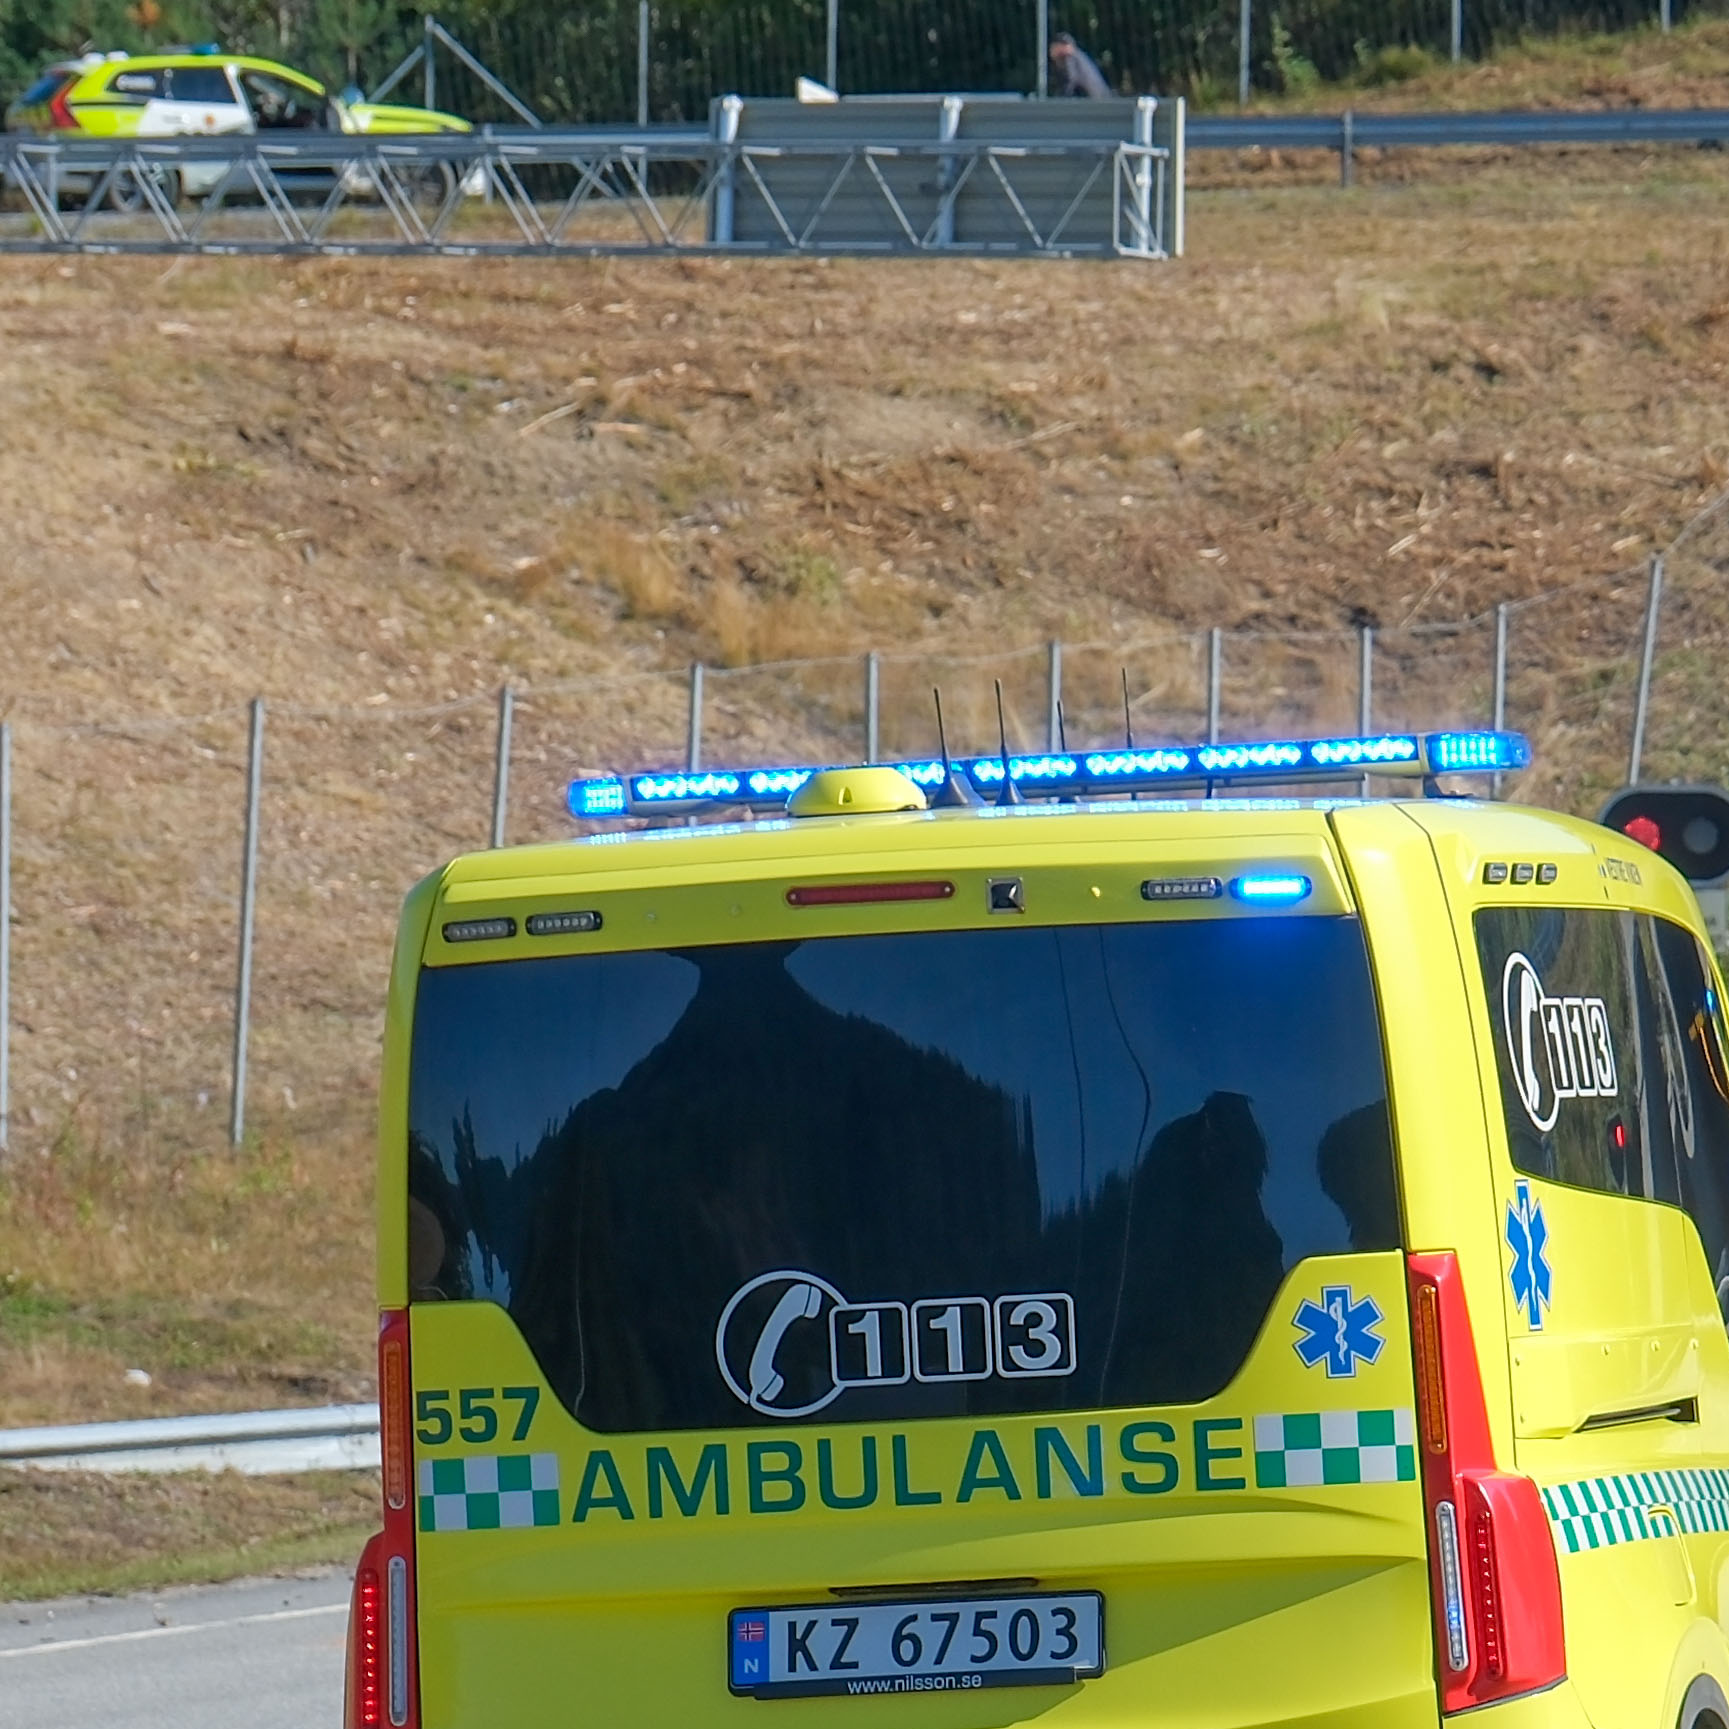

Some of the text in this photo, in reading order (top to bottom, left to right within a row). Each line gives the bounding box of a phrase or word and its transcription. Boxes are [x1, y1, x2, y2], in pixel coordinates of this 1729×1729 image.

[1546, 1005, 1614, 1089] 113
[846, 1299, 1062, 1380] 113
[416, 1386, 540, 1445] 557
[572, 1418, 1246, 1523] AMBULANSE
[743, 1657, 760, 1673] N
[786, 1606, 1078, 1673] KZ 67503
[846, 1674, 983, 1694] www.nilsson.se
